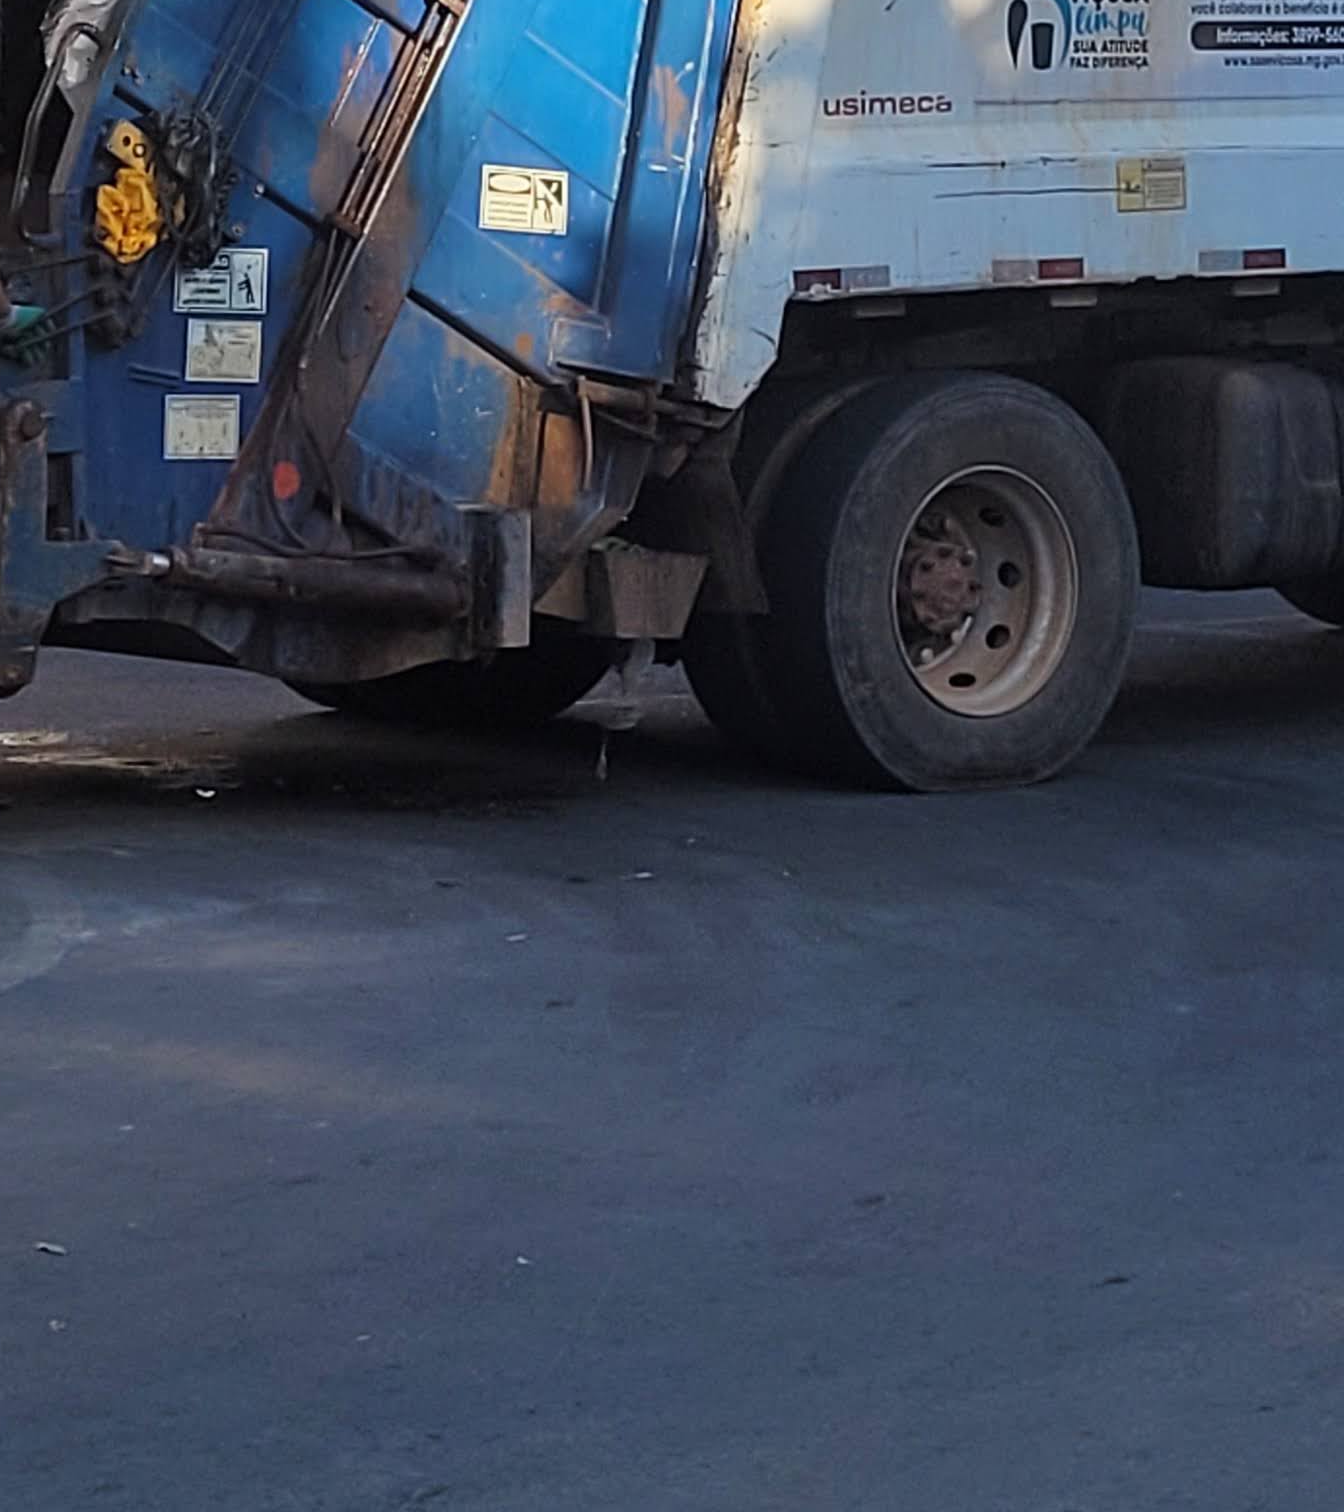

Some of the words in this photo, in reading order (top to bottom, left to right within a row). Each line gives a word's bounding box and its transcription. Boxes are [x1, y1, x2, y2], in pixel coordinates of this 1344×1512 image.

[1072, 39, 1098, 54] SUA
[1101, 39, 1149, 54] ATITUDE
[1070, 56, 1090, 69] FAZ
[1092, 56, 1150, 71] DIFERENÇA
[822, 91, 953, 117] usimeca
